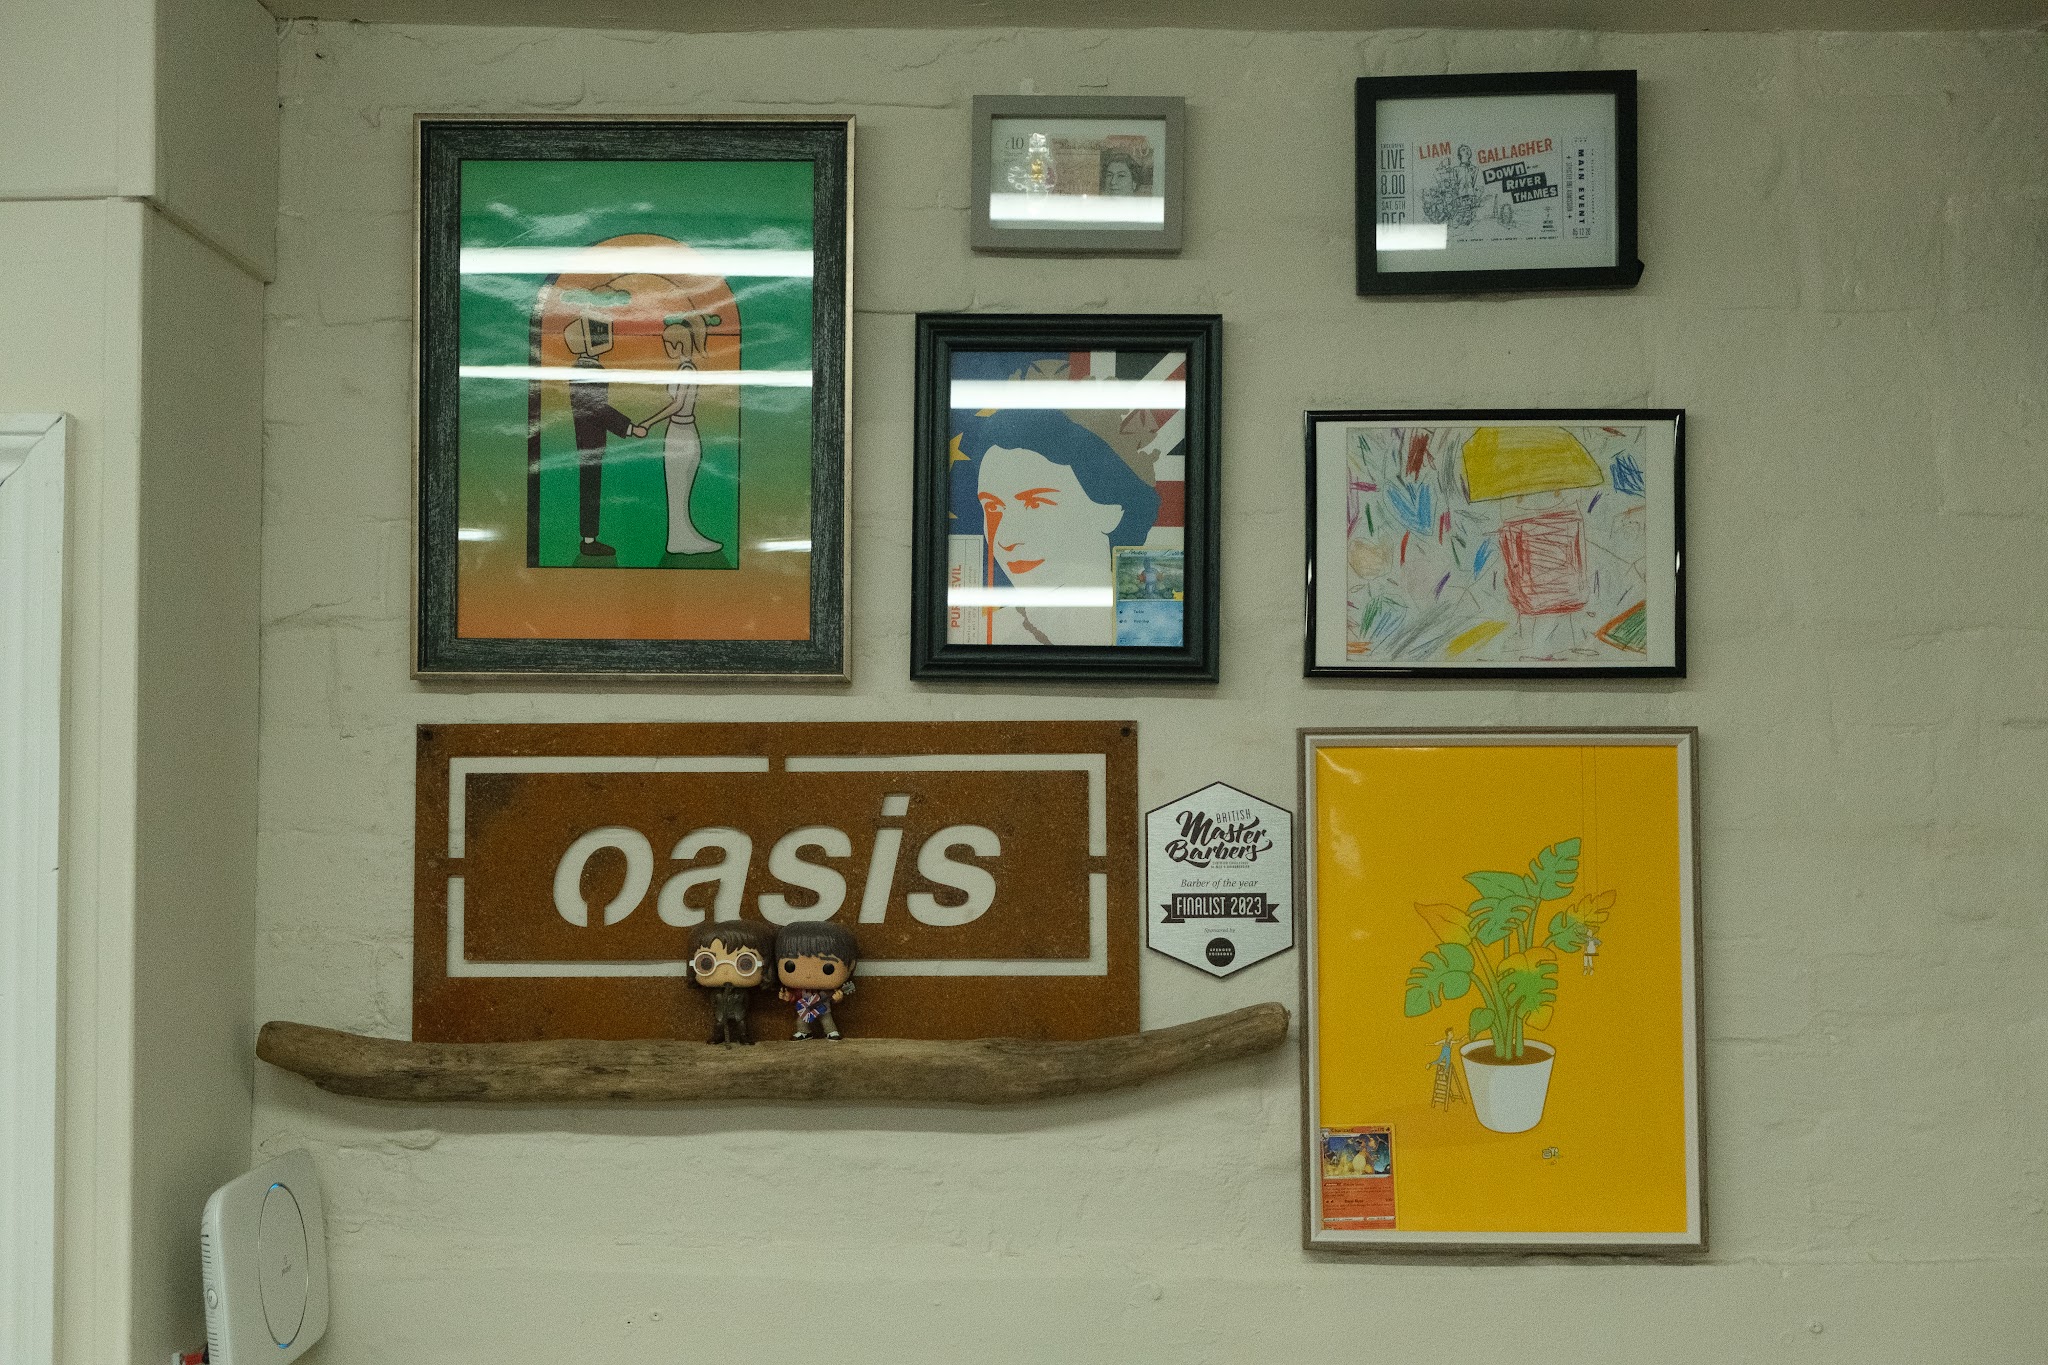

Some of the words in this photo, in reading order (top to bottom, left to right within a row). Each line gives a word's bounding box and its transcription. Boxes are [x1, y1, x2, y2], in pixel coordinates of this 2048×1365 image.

[1380, 149, 1405, 170] LIVE
[1419, 142, 1451, 159] LIAM
[1477, 138, 1553, 164] GALLAGHER
[1381, 174, 1406, 195] 8.00
[1506, 176, 1541, 190] RIVER
[1216, 809, 1250, 823] BRITISH
[1176, 810, 1267, 846] Master
[553, 795, 1002, 927] oasis
[1165, 838, 1273, 868] Barbers
[1181, 879, 1210, 888] Barber
[1211, 879, 1221, 889] of
[1223, 879, 1236, 888] the
[1238, 880, 1258, 889] year
[1176, 897, 1226, 915] FINALIST
[1231, 896, 1262, 915] 2023
